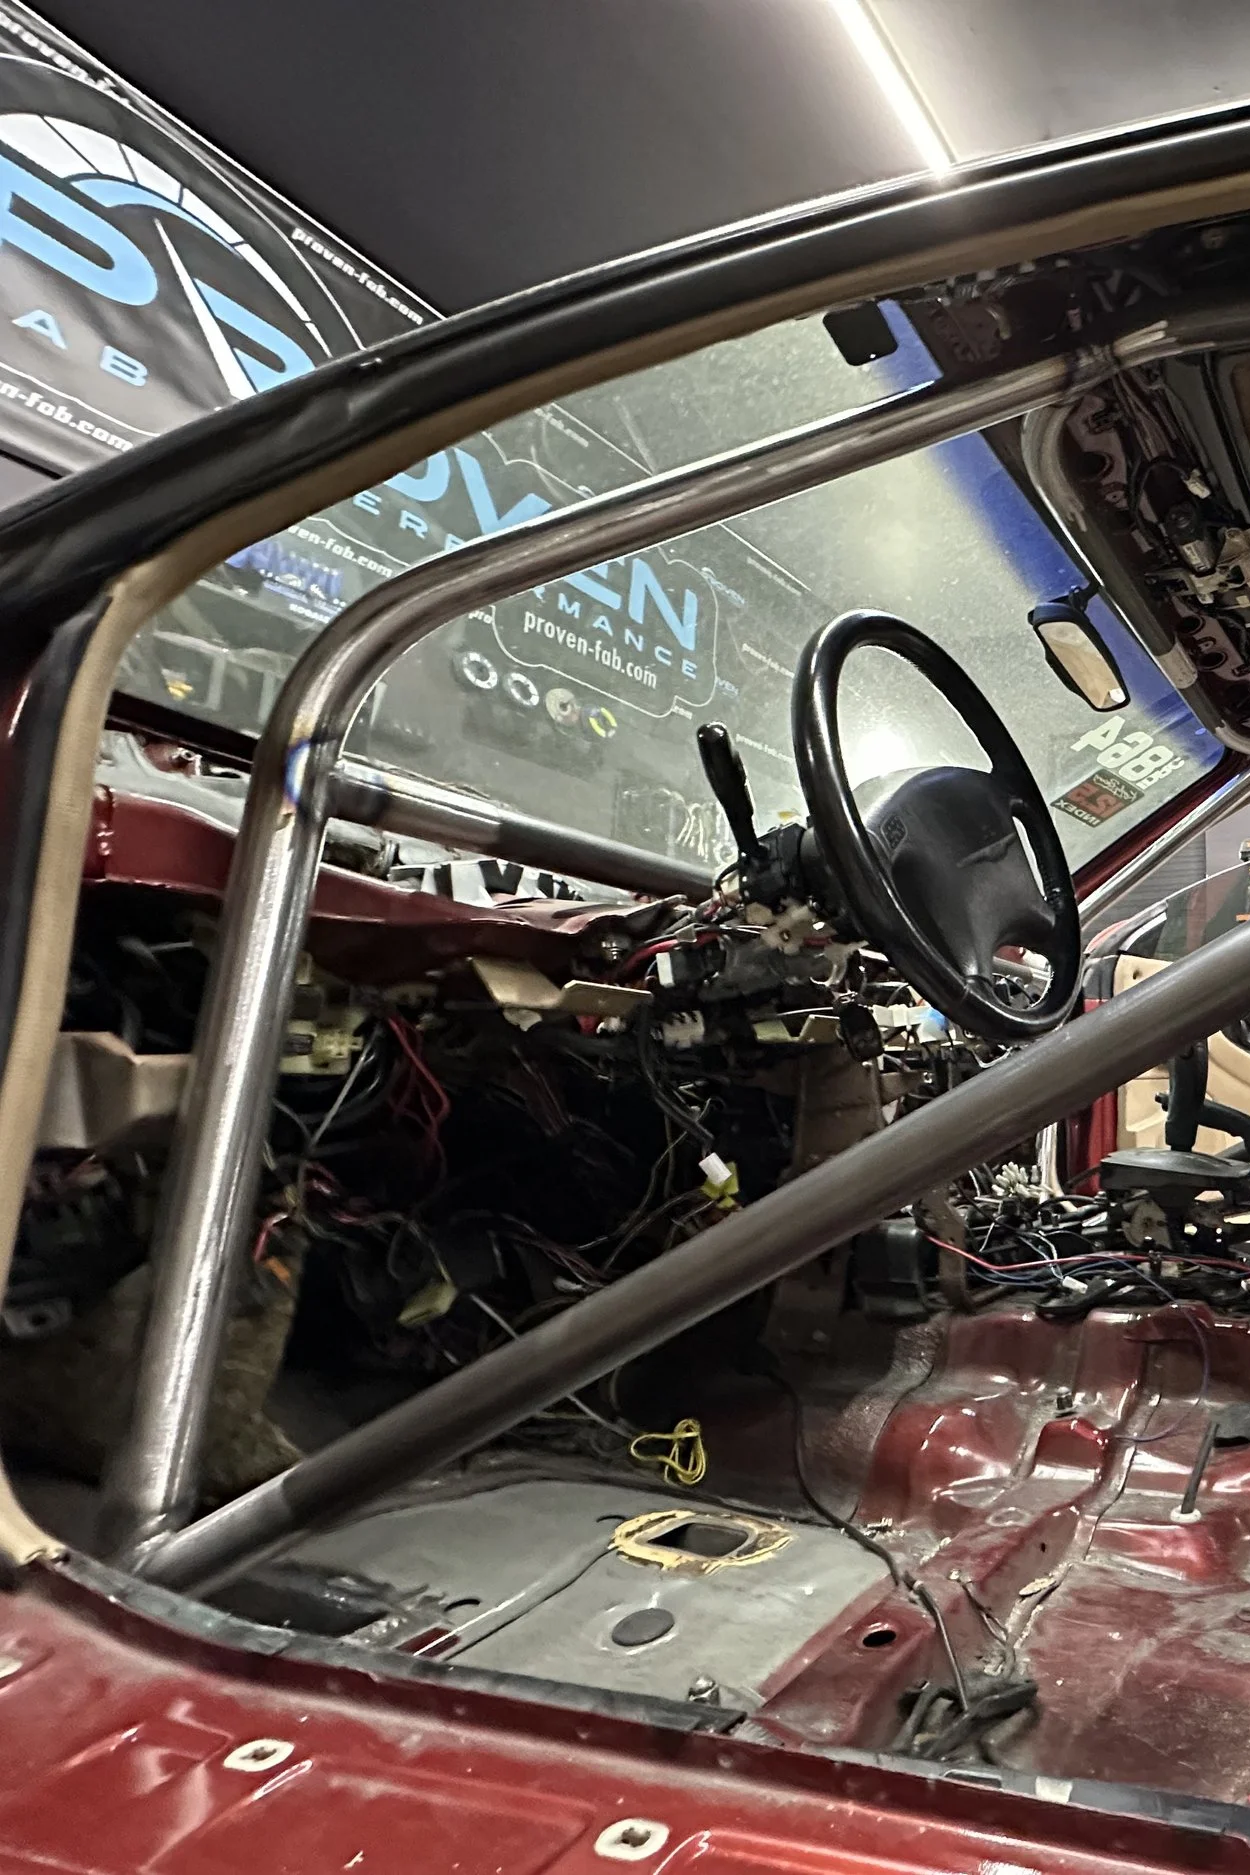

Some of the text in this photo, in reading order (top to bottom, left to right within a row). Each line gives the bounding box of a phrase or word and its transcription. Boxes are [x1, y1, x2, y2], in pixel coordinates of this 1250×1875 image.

[291, 227, 423, 325] proven-fab.com
[0, 380, 134, 452] n-fab.com
[523, 610, 658, 689] proven-fab.com
